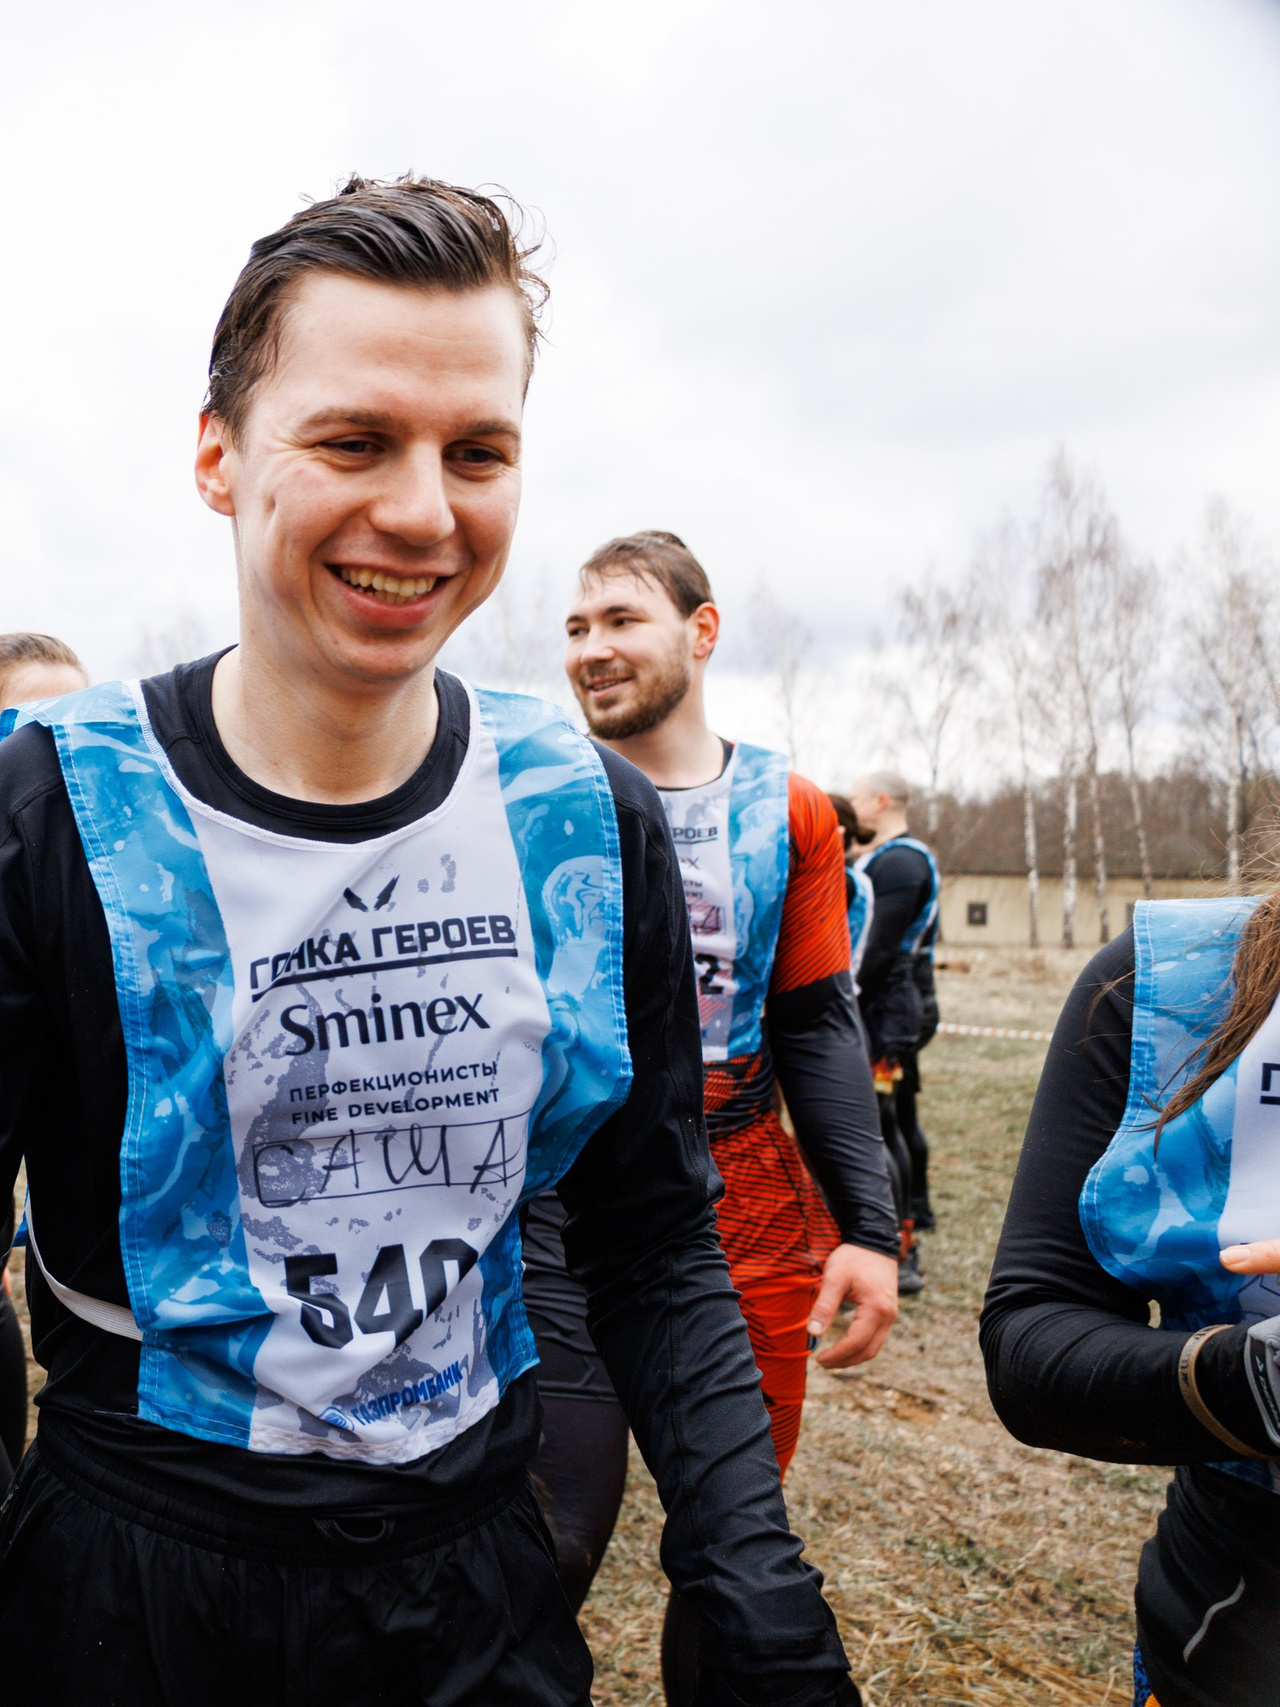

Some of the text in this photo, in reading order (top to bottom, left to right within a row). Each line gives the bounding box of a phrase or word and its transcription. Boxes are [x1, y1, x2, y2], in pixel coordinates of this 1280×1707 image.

[249, 914, 517, 990] ГОНКА ГЕРОЕВ
[279, 993, 492, 1057] Sminex
[289, 1060, 499, 1103] ПЕРФЕКЦИОНИСТЫ
[291, 1088, 501, 1126] FINE DEVELOPMENT
[253, 1118, 520, 1207] САША
[351, 1361, 464, 1427] ГАЗПРОМБАНК
